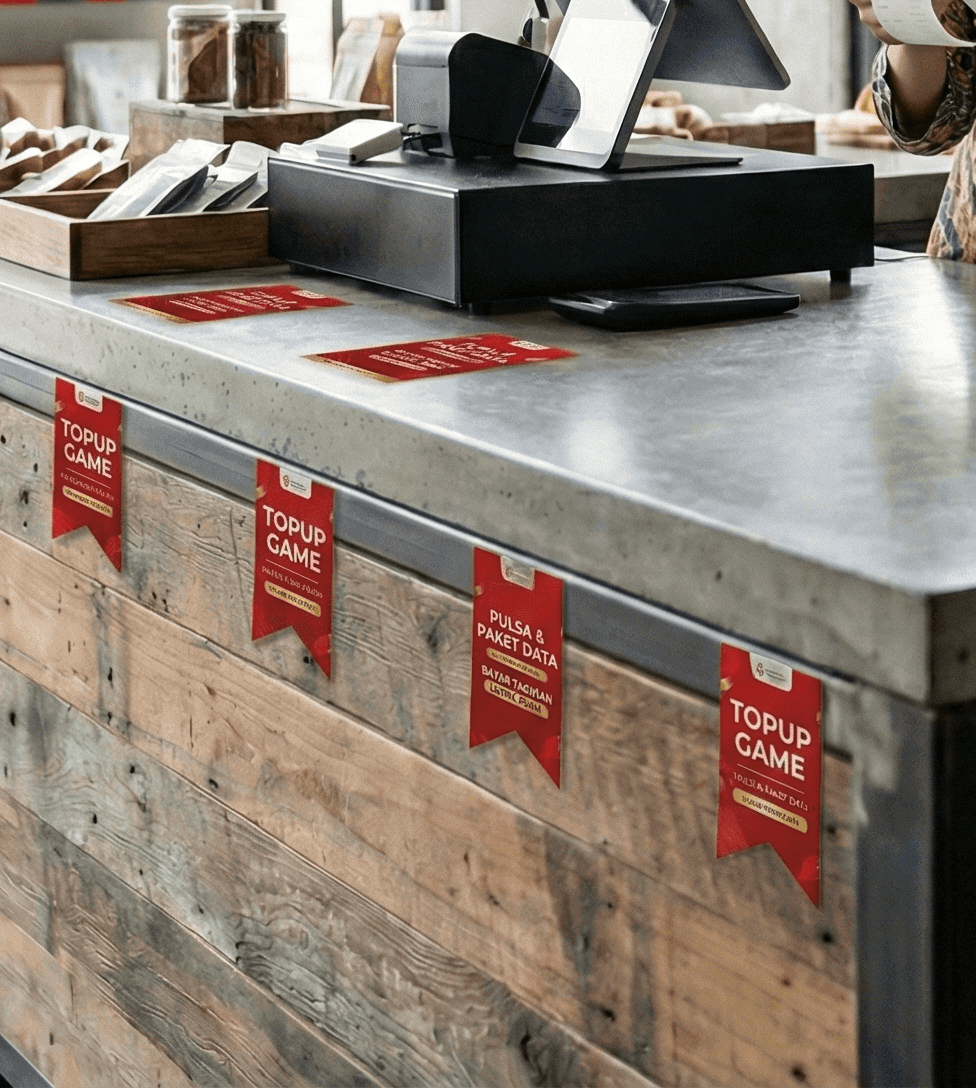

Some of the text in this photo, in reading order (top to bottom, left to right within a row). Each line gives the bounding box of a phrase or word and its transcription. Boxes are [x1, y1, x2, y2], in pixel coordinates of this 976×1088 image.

[60, 417, 117, 456] TOPUP
[64, 443, 112, 479] GAME
[262, 504, 326, 547] TOPUP
[266, 533, 321, 574] GAME
[477, 622, 519, 652] PAKET
[522, 641, 558, 670] DATA
[490, 609, 544, 644] PULSA &
[730, 698, 812, 749] TOPUP
[735, 731, 805, 781] GAME
